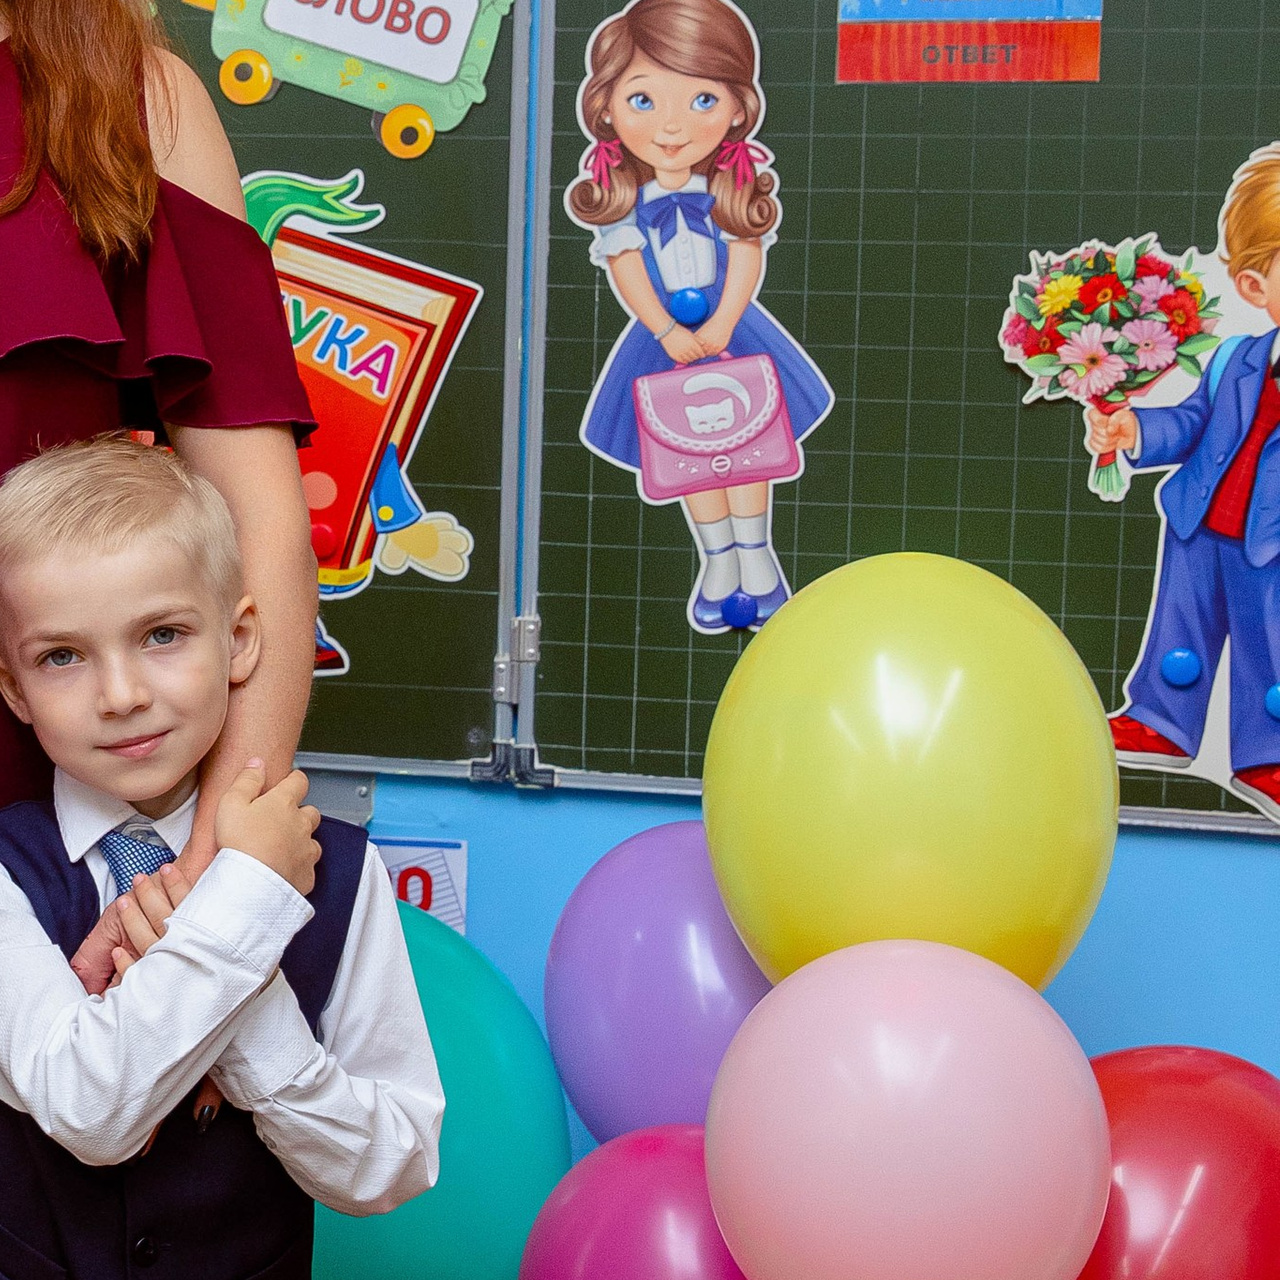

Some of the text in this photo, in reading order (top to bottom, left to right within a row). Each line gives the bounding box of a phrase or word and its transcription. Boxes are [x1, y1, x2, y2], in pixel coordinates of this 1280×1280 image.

[921, 42, 1018, 68] ОТВЕТ
[281, 293, 397, 396] УКА
[387, 864, 434, 911] 0
